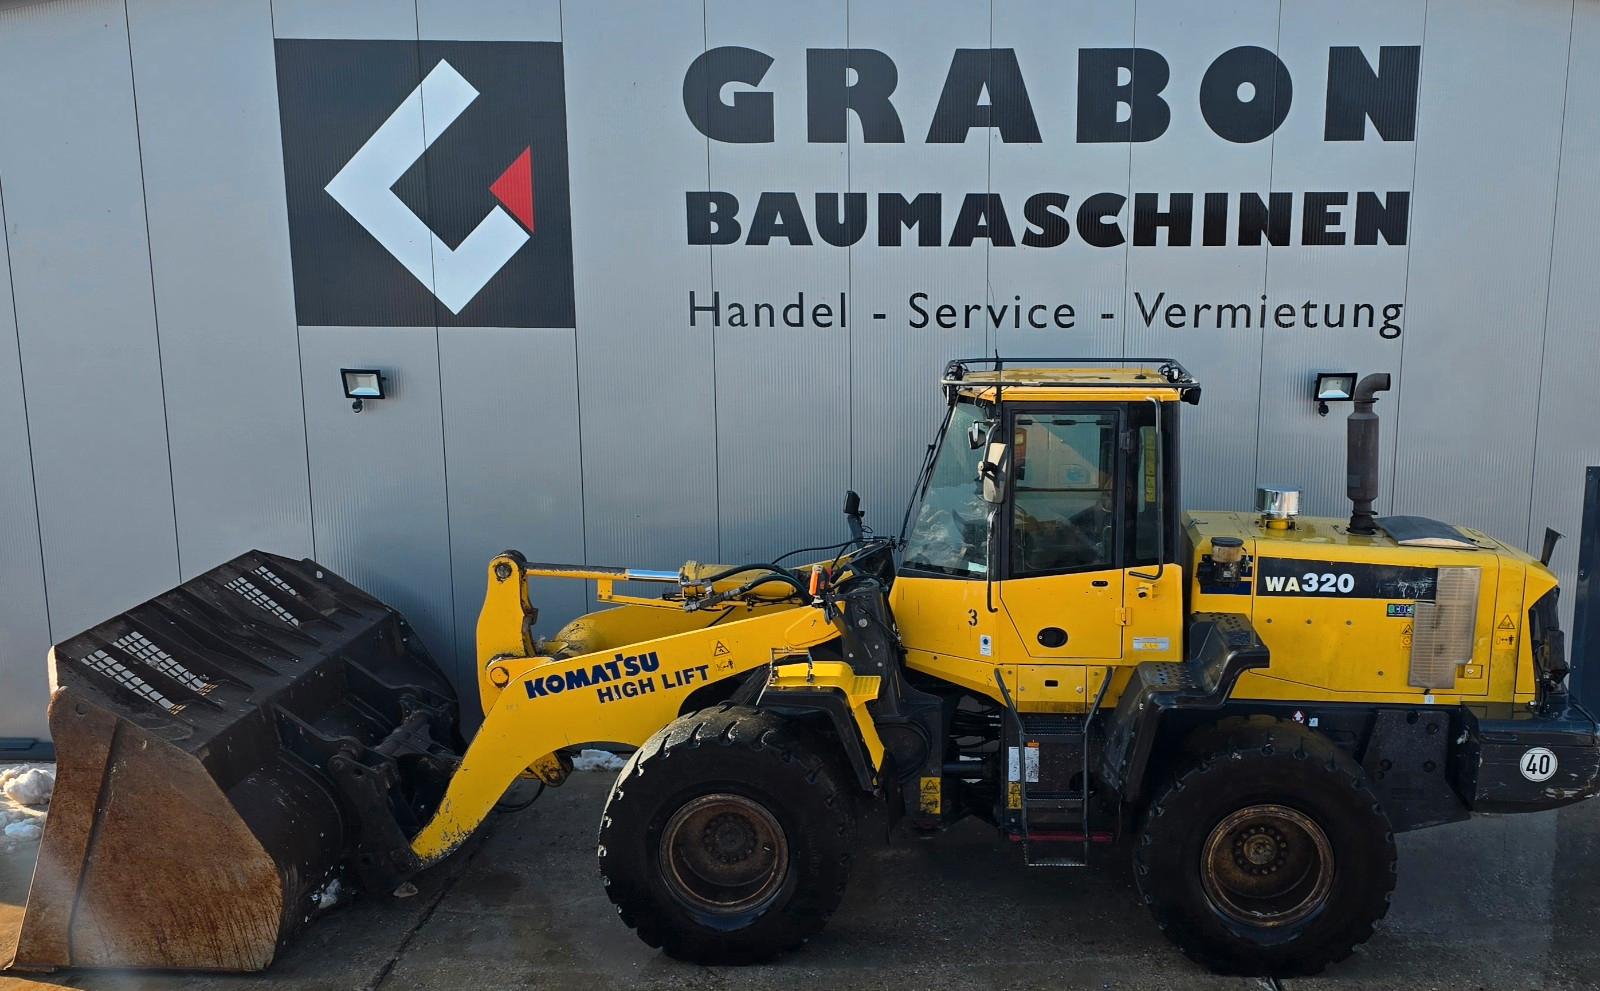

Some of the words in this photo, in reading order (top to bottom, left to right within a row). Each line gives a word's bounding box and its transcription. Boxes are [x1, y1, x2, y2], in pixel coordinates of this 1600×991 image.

[683, 45, 1421, 143] GRABON
[685, 191, 1411, 248] BAUMASCHINEN
[689, 291, 847, 327] Handel
[909, 292, 1076, 329] Service
[1134, 292, 1404, 340] Vermietung
[1265, 572, 1355, 593] WA320
[968, 608, 978, 626] 3
[524, 651, 660, 700] KOMATSU
[596, 677, 656, 704] HIGH
[661, 665, 709, 690] LIFT
[1525, 754, 1551, 775] 40
